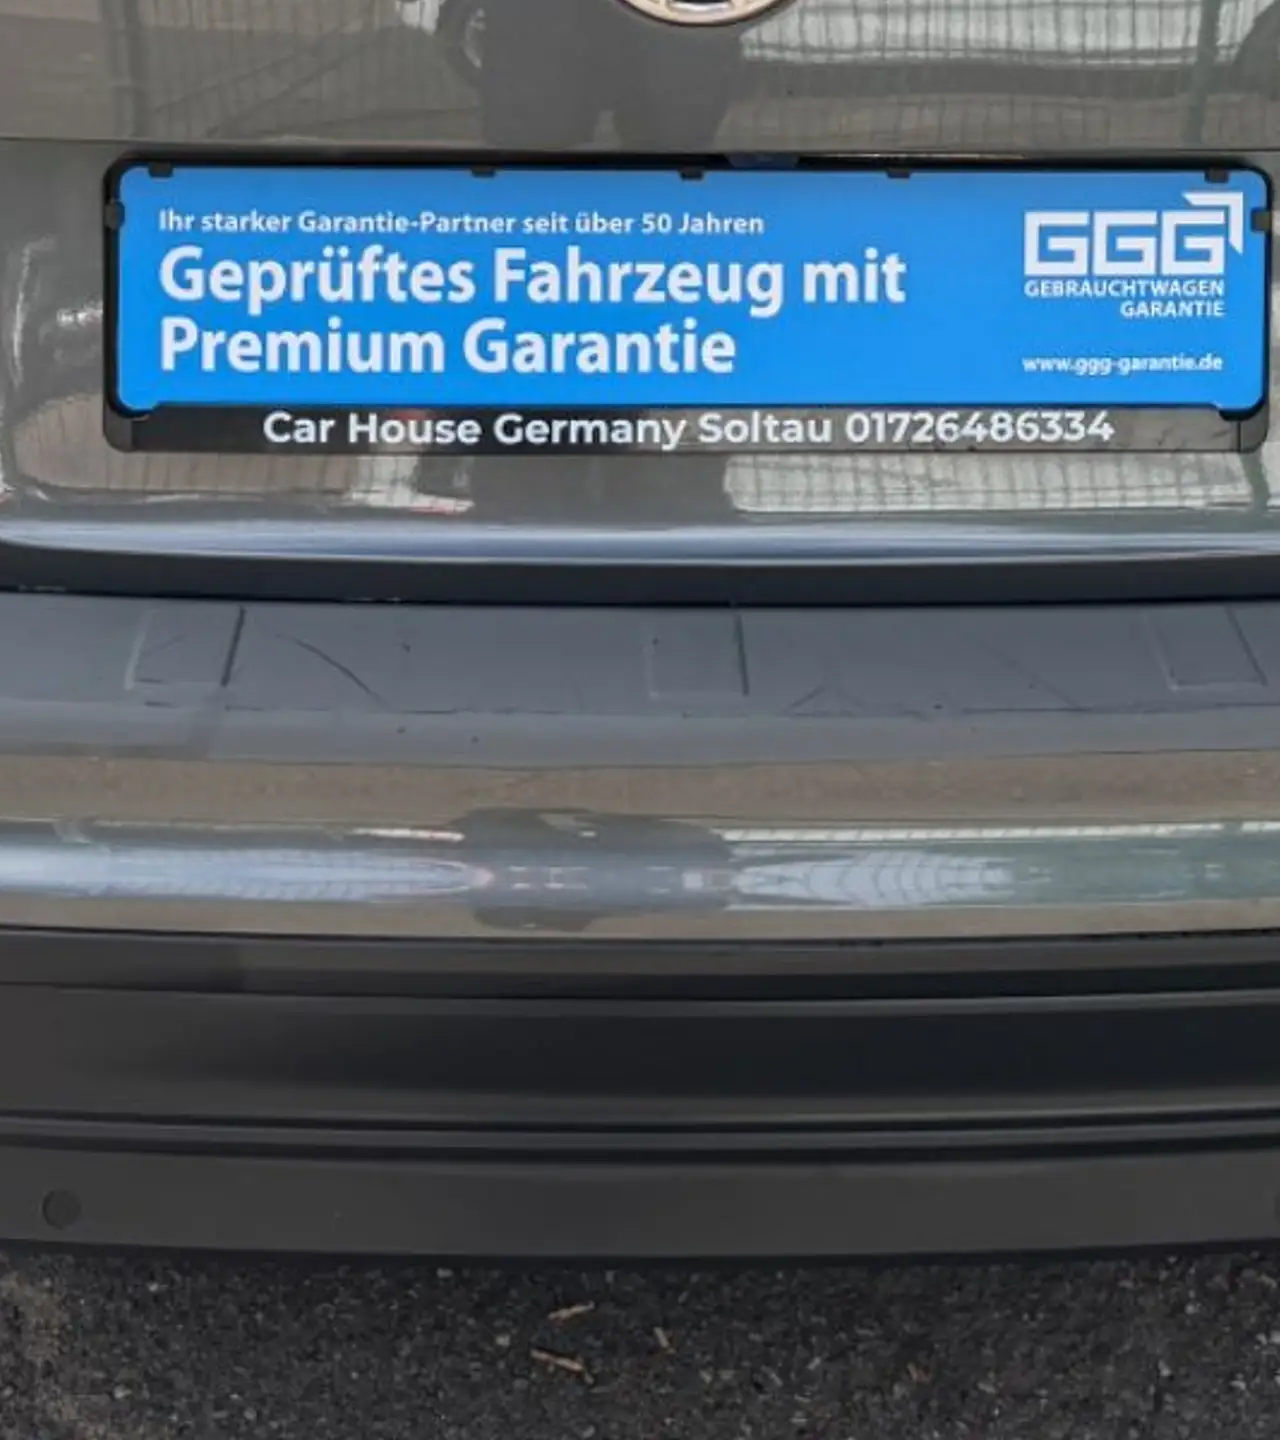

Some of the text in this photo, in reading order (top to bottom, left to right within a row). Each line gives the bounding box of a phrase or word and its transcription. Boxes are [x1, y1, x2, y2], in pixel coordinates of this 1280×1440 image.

[159, 208, 764, 234] Ihr starker Garantie-Partner seit über 50 Jahren
[1024, 211, 1225, 276] GGG
[160, 244, 907, 318] Geprüftes Fahrzeug mit
[1023, 278, 1225, 297] GEBRAUCHTWAGEN
[1120, 299, 1226, 318] GARANTIE
[161, 316, 736, 374] Premium Garantie
[1022, 354, 1223, 375] www.ggg-garantie.de
[263, 411, 1115, 450] Car House Germany Soltau 01726486334
